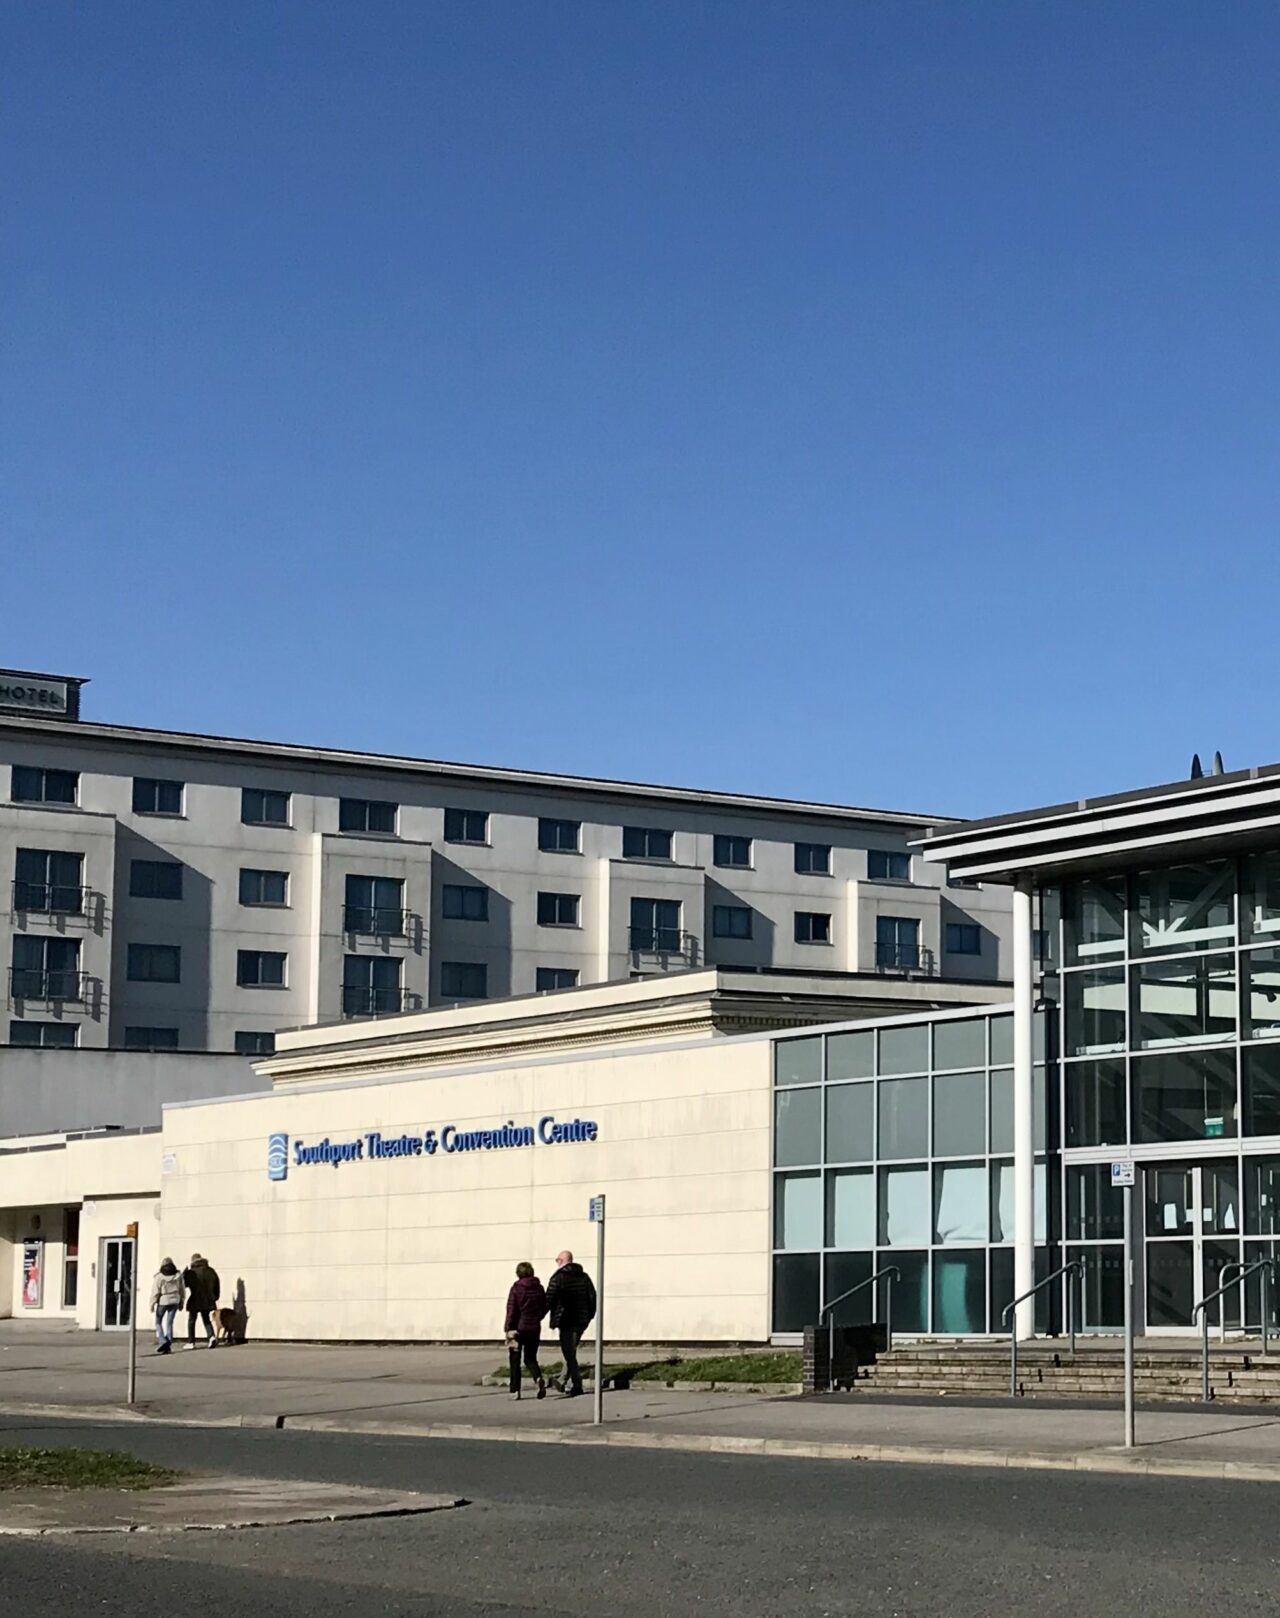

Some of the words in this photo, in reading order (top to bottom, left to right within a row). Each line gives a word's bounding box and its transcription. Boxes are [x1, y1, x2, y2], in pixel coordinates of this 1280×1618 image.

[0, 685, 58, 703] HOTEL
[293, 1136, 363, 1167] Southport
[364, 1132, 422, 1159] Theatre
[424, 1130, 439, 1154] &
[440, 1120, 535, 1153] Convention
[537, 1115, 599, 1145] Centre
